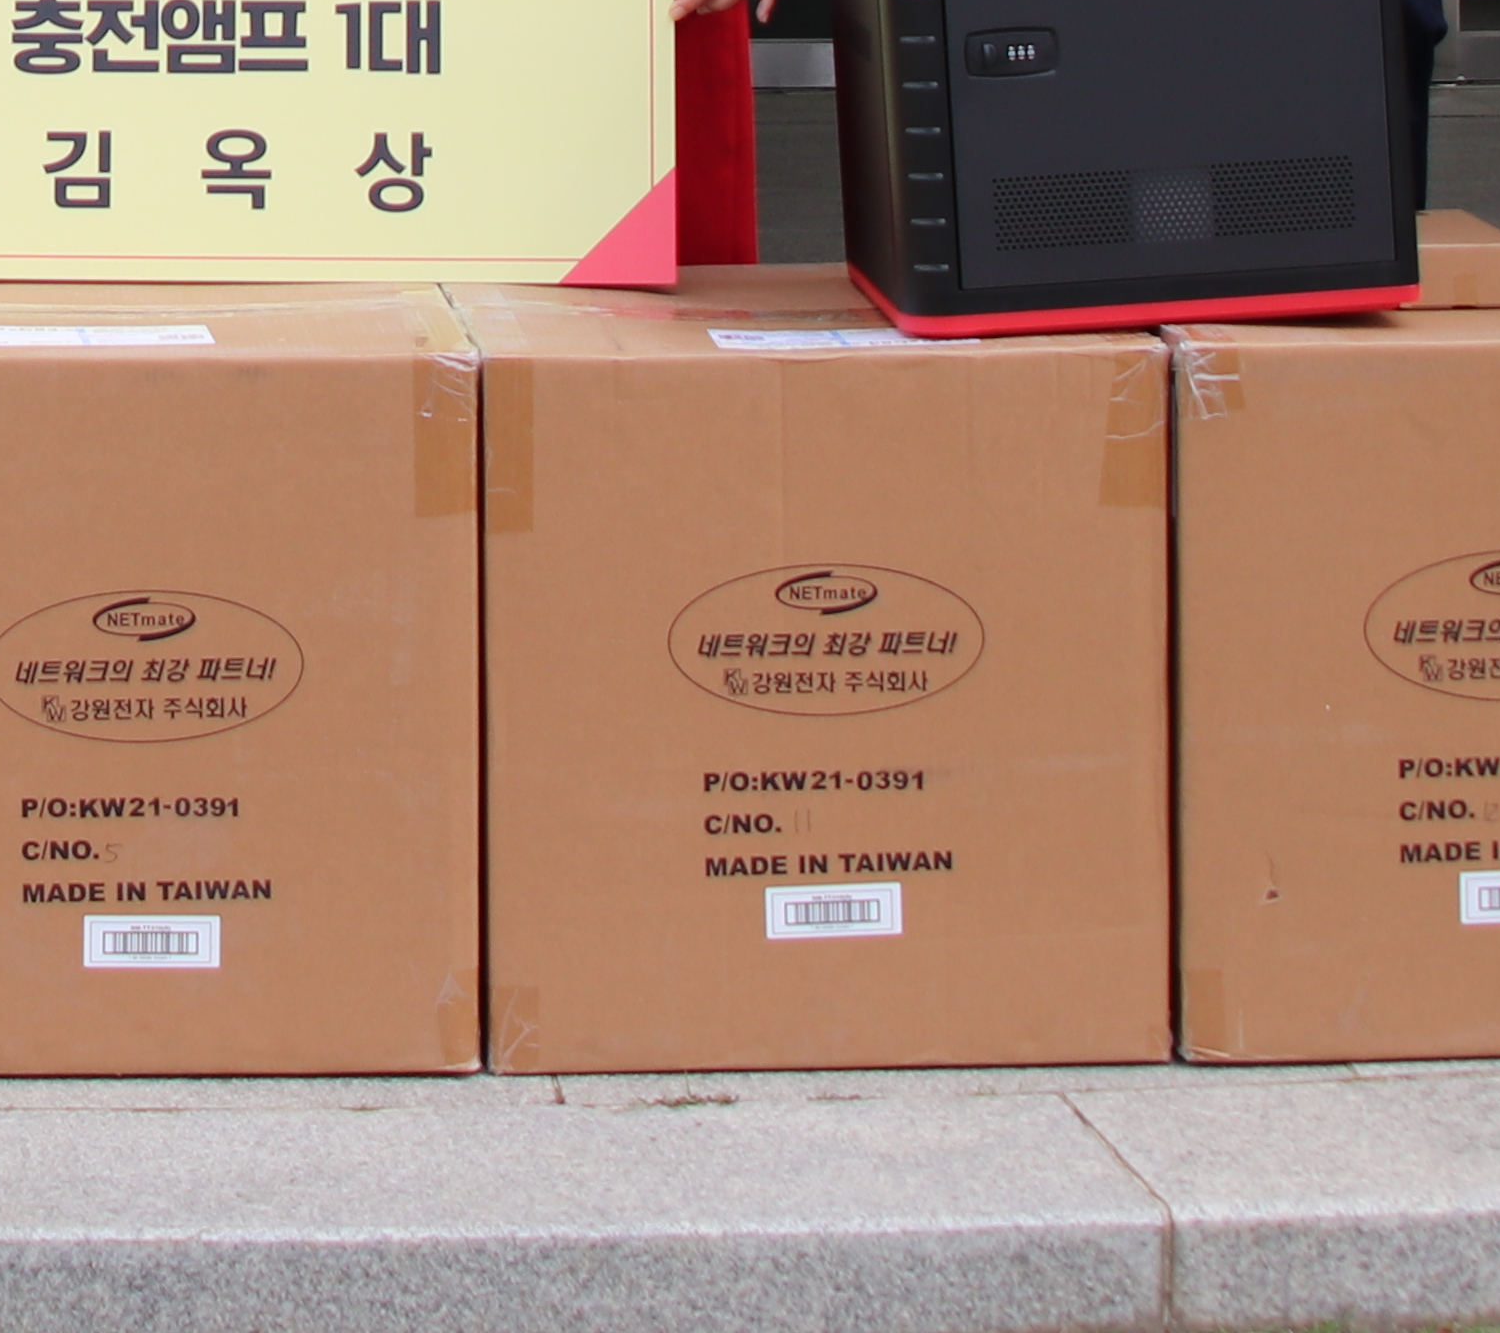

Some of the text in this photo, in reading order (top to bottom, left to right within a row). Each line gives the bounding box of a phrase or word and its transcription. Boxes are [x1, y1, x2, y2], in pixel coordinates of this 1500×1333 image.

[336, 0, 442, 77] 1대
[46, 133, 112, 209] 김
[201, 132, 272, 212] 옥
[356, 131, 434, 213] 상
[787, 584, 869, 599] NETmate
[105, 611, 187, 627] NETmate
[697, 631, 958, 659] 네트워크의 최강 파트너!
[15, 657, 277, 685] 네트워크의 최강 파트너!
[752, 670, 928, 695] 강원전자 주식회사
[71, 696, 248, 722] 강원전자 주식회사
[703, 770, 924, 793] P/O:KW21-0391
[21, 797, 239, 819] P/O:KW21-0391
[1399, 799, 1475, 822] C/NO.
[704, 813, 782, 835] C/NO.
[21, 840, 123, 863] C/NO. 5
[1400, 841, 1481, 864] MADE
[705, 850, 953, 878] MADE IN TAIWAN
[22, 879, 272, 904] MADE IN TAIWAN
